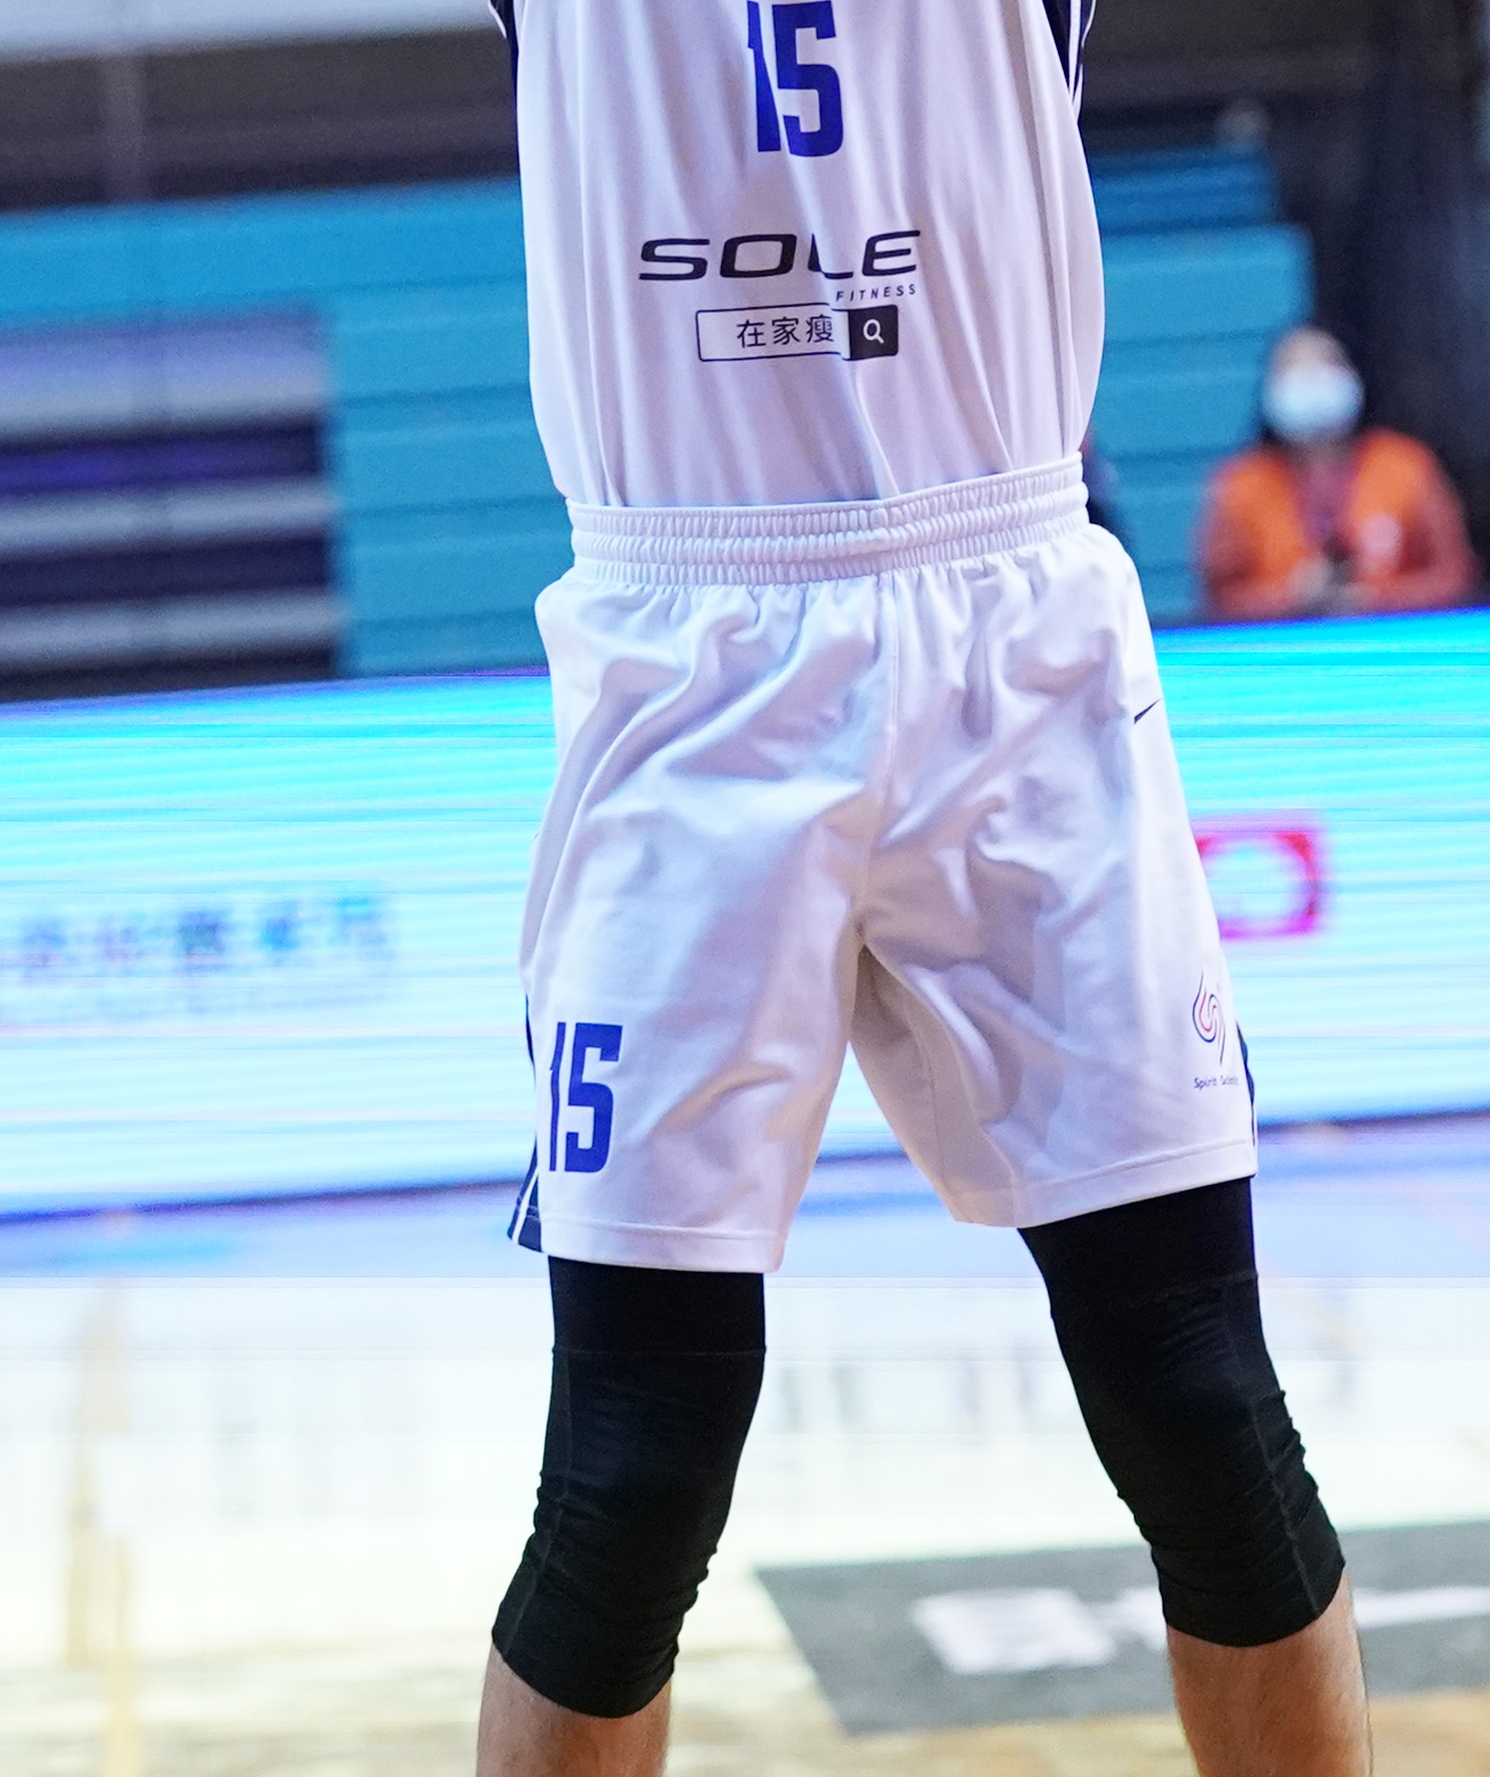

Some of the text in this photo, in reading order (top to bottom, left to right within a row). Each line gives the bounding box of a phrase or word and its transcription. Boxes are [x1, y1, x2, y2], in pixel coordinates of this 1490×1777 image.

[639, 230, 922, 281] SOLE
[836, 283, 916, 303] FITNESS
[736, 314, 835, 350] 在家瘦
[548, 1021, 623, 1173] 15
